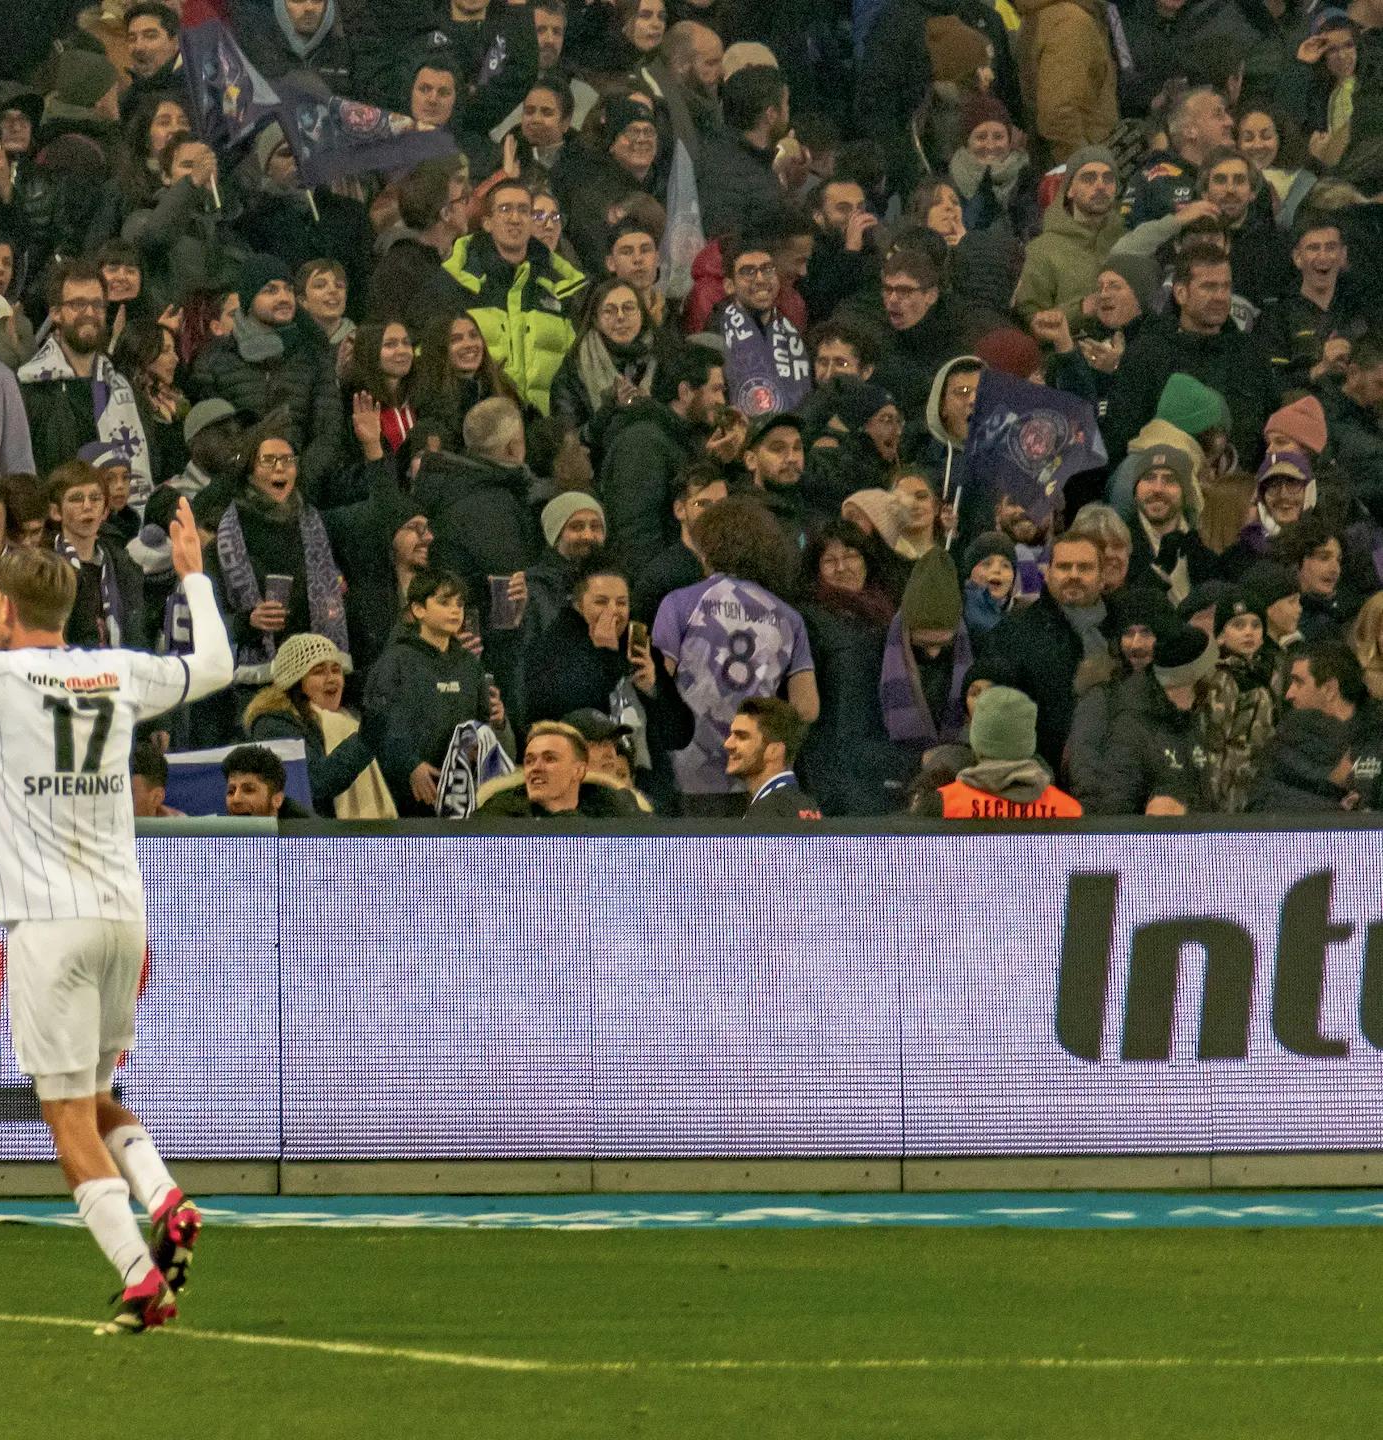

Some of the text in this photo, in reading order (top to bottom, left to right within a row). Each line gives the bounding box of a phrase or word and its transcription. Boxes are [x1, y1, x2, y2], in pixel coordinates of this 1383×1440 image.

[721, 628, 756, 692] 8
[42, 694, 115, 773] 17
[23, 774, 125, 797] SPIERINGS
[1056, 869, 1383, 1060] Int
